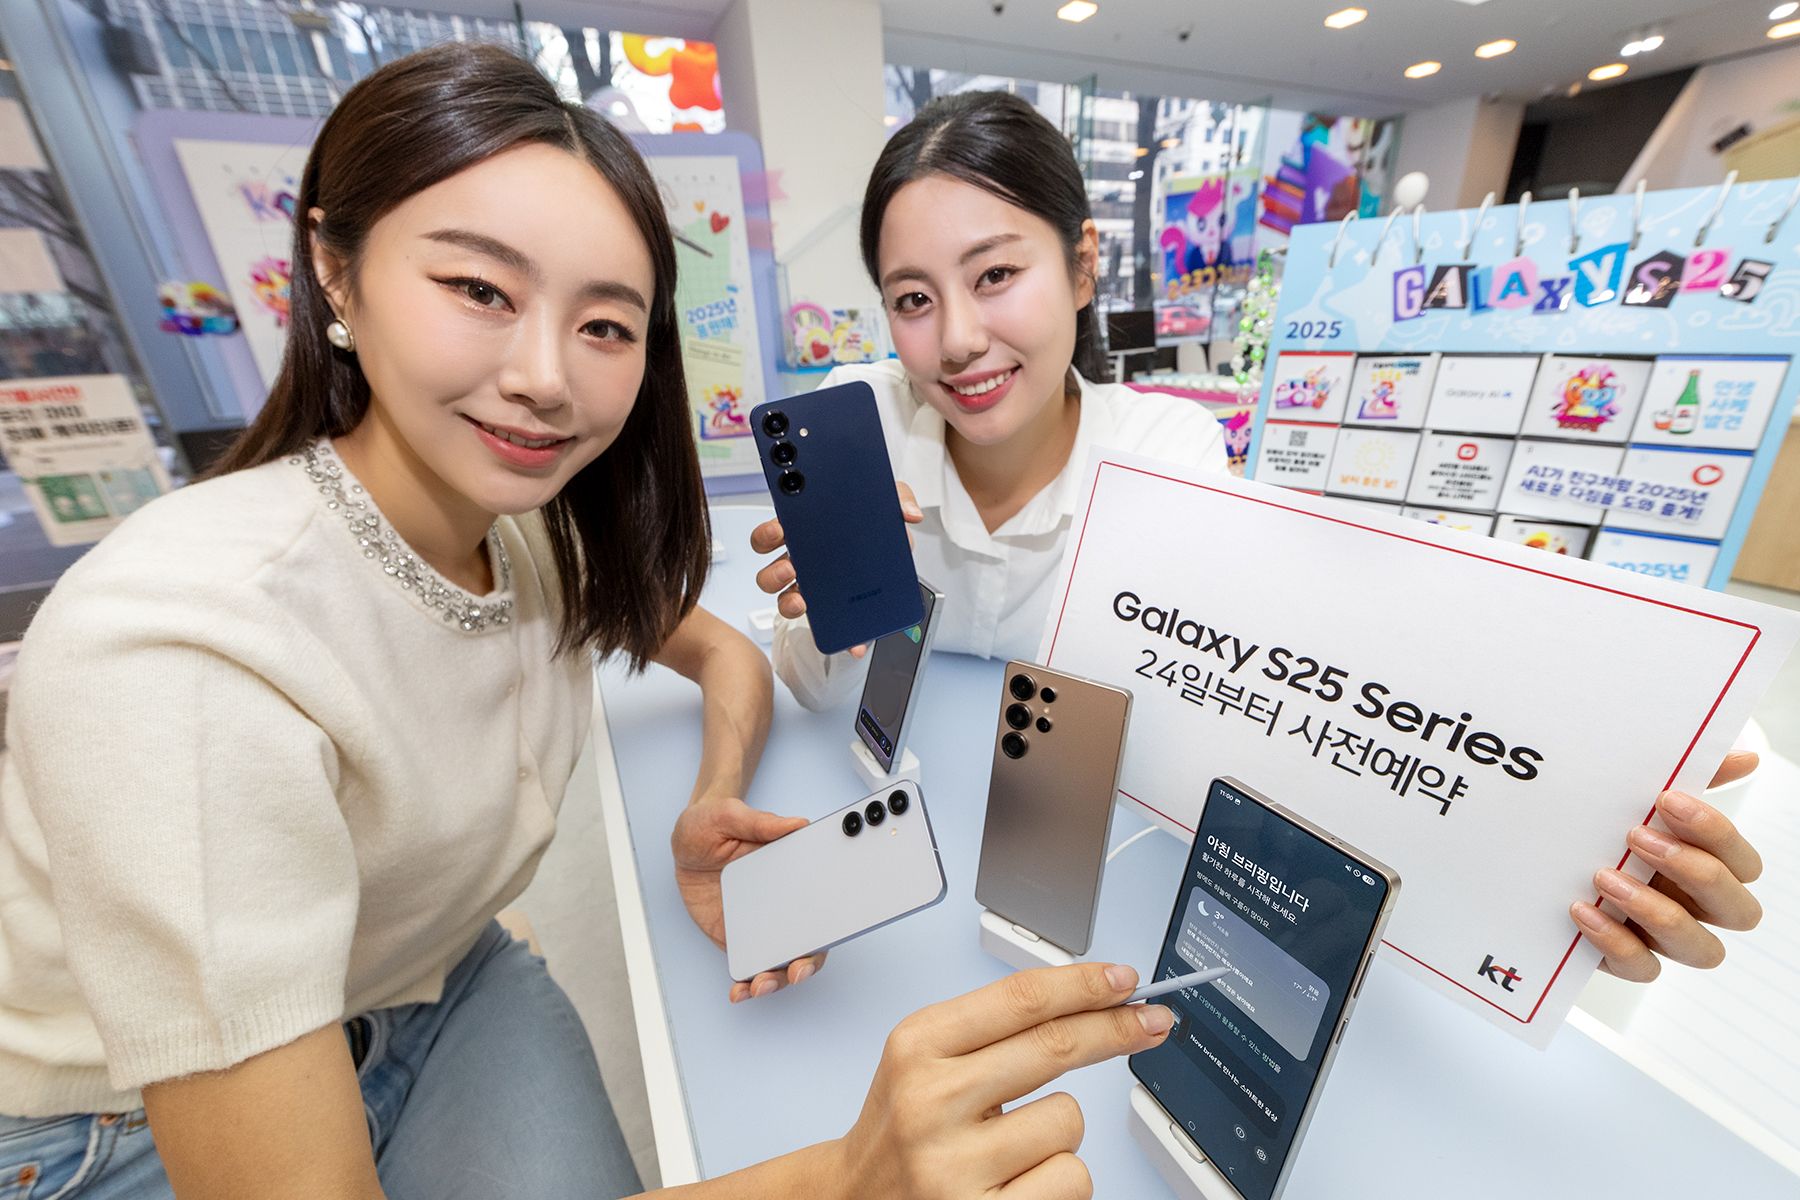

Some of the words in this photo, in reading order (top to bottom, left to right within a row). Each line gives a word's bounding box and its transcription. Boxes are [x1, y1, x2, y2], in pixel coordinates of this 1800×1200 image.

[687, 299, 737, 324] 2025년
[1285, 320, 1343, 340] 2025
[1520, 478, 1563, 498] 새로운
[1527, 464, 1565, 480] AI가
[1568, 470, 1634, 494] 친구처럼
[1637, 481, 1709, 507] 2025년
[1113, 591, 1259, 674] Galaxy
[1261, 646, 1349, 703] S25
[1353, 681, 1544, 782] Series
[1135, 649, 1284, 737] 24일부터
[1288, 714, 1469, 816] 사전예약
[1219, 789, 1234, 801] 11:00
[1202, 852, 1223, 872] 활기찬
[1224, 867, 1246, 889] 하루를
[1247, 884, 1271, 906] 시작해
[1271, 901, 1298, 926] 보세요.
[1207, 835, 1231, 859] 아침
[1231, 851, 1310, 913] 브리핑입니다
[1213, 883, 1232, 901] 하늘에
[1231, 896, 1250, 914] 구름이
[1250, 910, 1271, 930] 많아요.
[1213, 910, 1225, 920] 3°
[1196, 936, 1221, 961] 초미세먼지는
[1477, 954, 1523, 993] kt
[1199, 994, 1222, 1019] 다양하게
[1240, 1034, 1248, 1042] 수
[1248, 1040, 1261, 1056] 있는
[1261, 1052, 1282, 1074] 방법을
[1190, 1034, 1203, 1049] Now
[1203, 1047, 1223, 1069] brief로
[1222, 1064, 1240, 1086] 만나는
[1240, 1084, 1265, 1109] 스마트한
[1264, 1106, 1279, 1123] 일상
